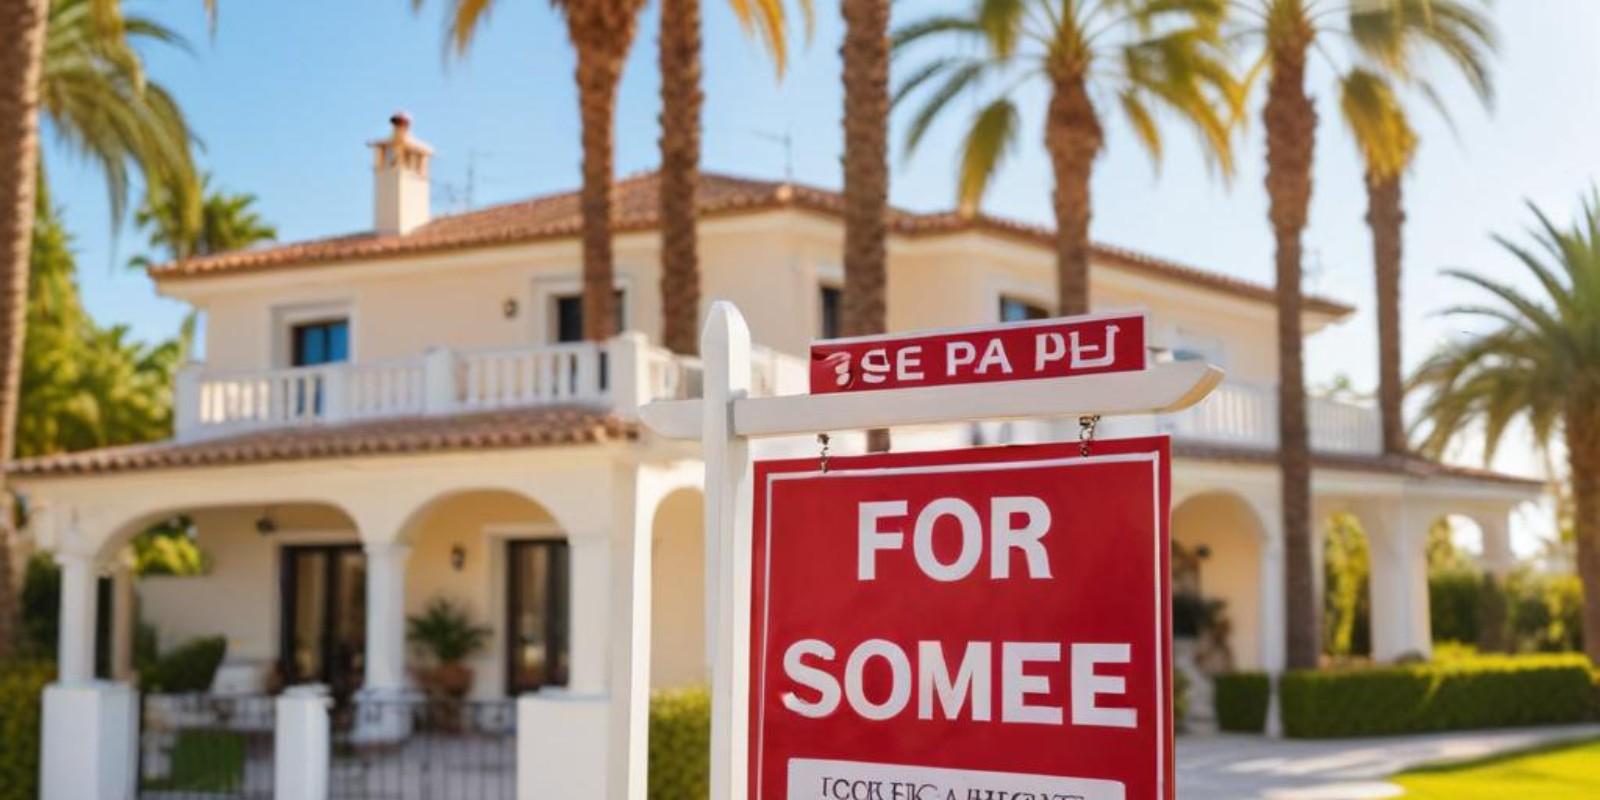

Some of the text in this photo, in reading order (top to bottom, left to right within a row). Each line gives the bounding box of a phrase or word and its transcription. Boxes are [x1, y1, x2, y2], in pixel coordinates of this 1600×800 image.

[946, 338, 1013, 376] PA
[857, 496, 1053, 582] FOR
[781, 638, 1138, 729] SOMEE
